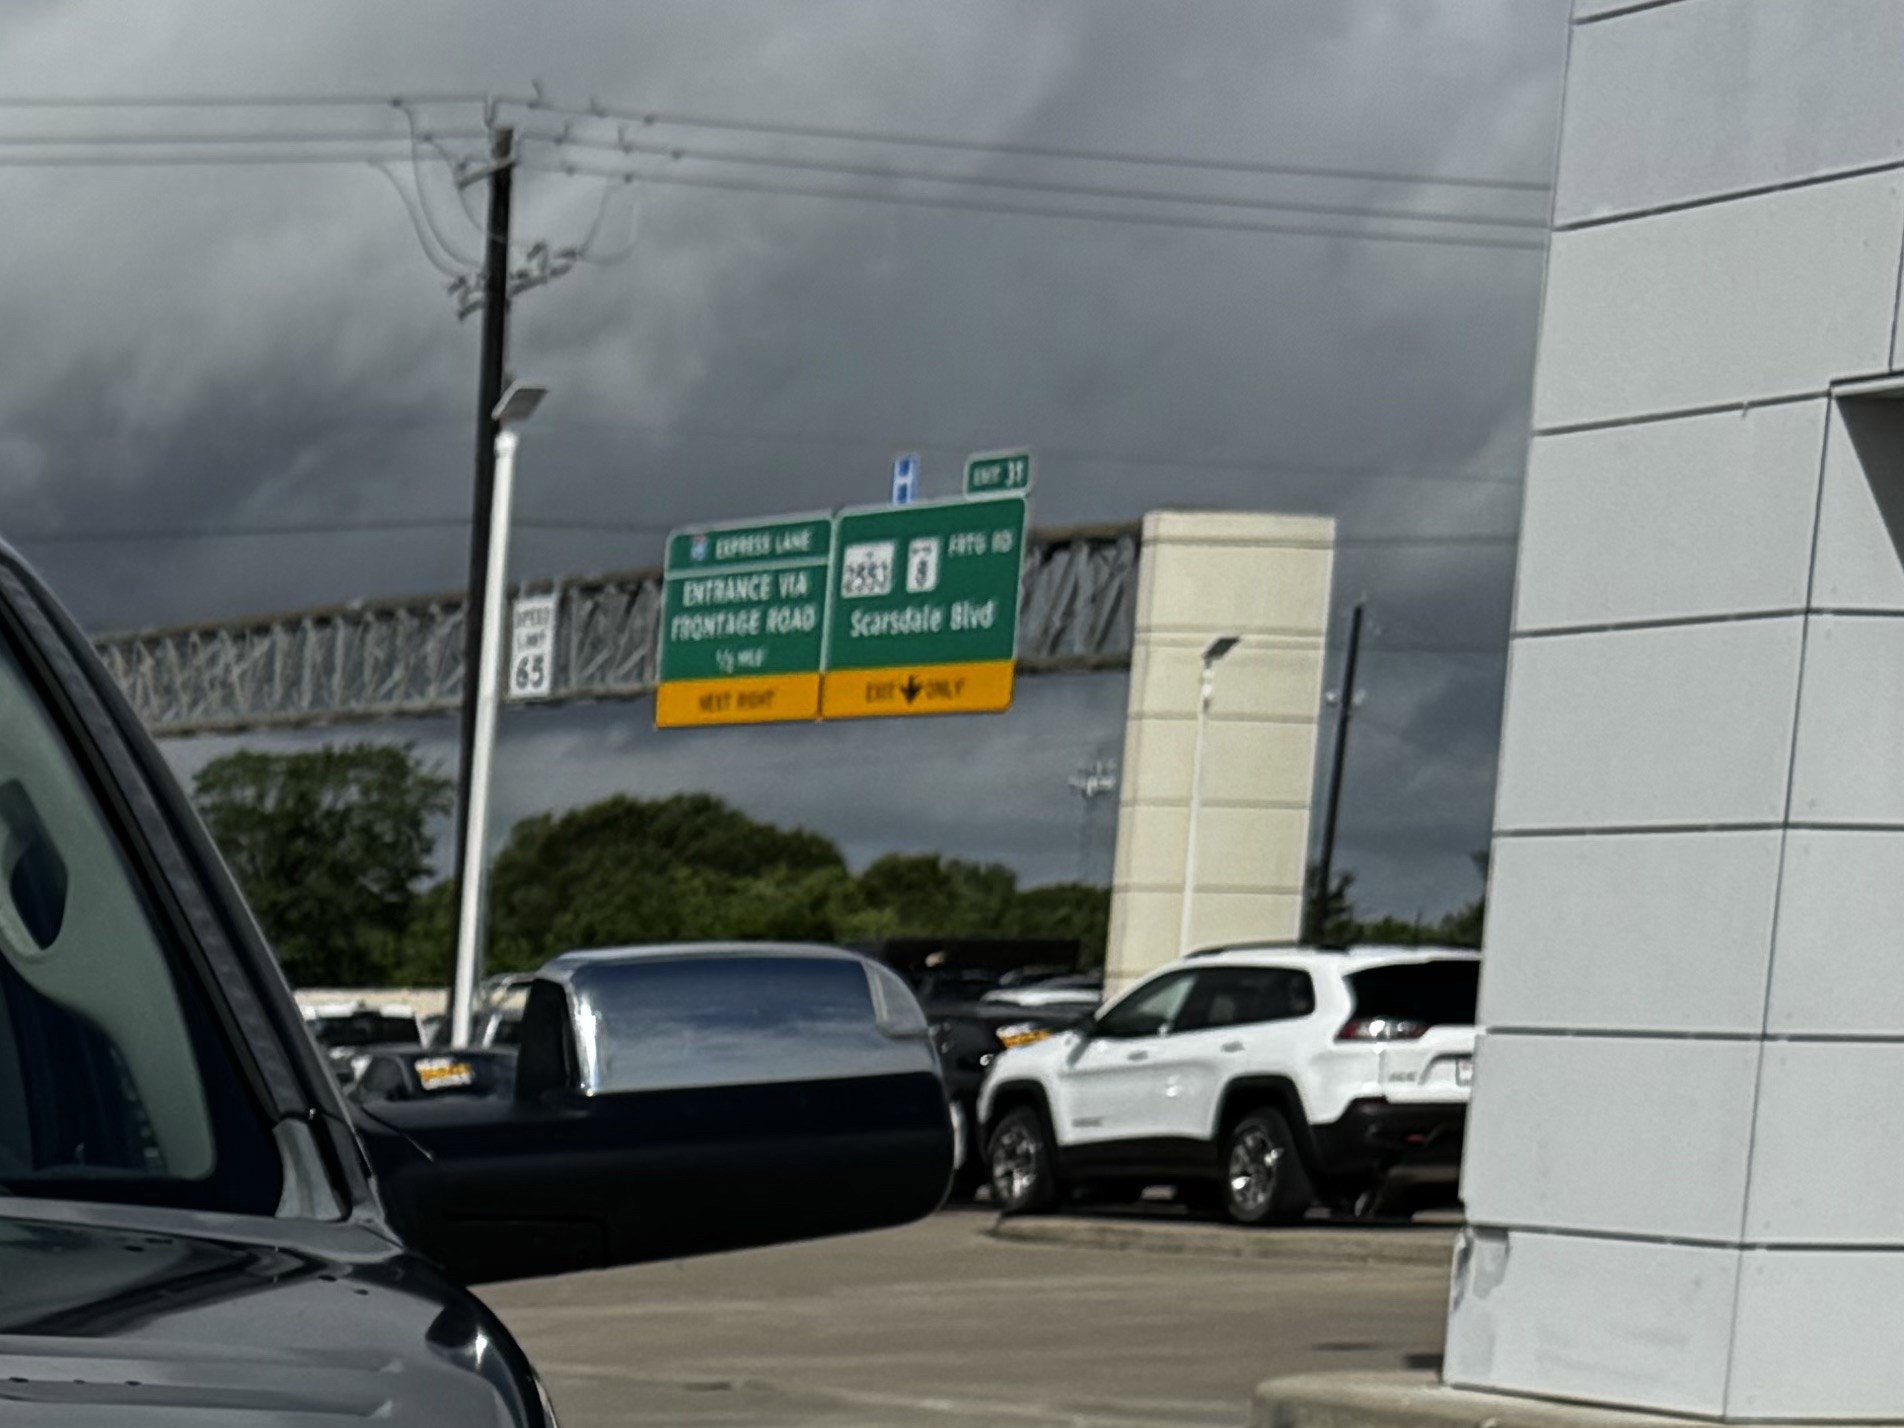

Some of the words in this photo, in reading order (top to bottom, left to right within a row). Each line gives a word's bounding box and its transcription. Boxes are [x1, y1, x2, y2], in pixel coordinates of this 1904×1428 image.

[714, 531, 771, 560] EXPRESS
[775, 527, 812, 554] LANE
[682, 572, 772, 607] ENTRANCE
[778, 569, 809, 599] VIA
[670, 607, 762, 642] FRONTAGE
[765, 603, 817, 635] ROAD
[850, 603, 942, 638] Scarsdale
[950, 599, 996, 631] Blvd
[516, 654, 545, 690] 65
